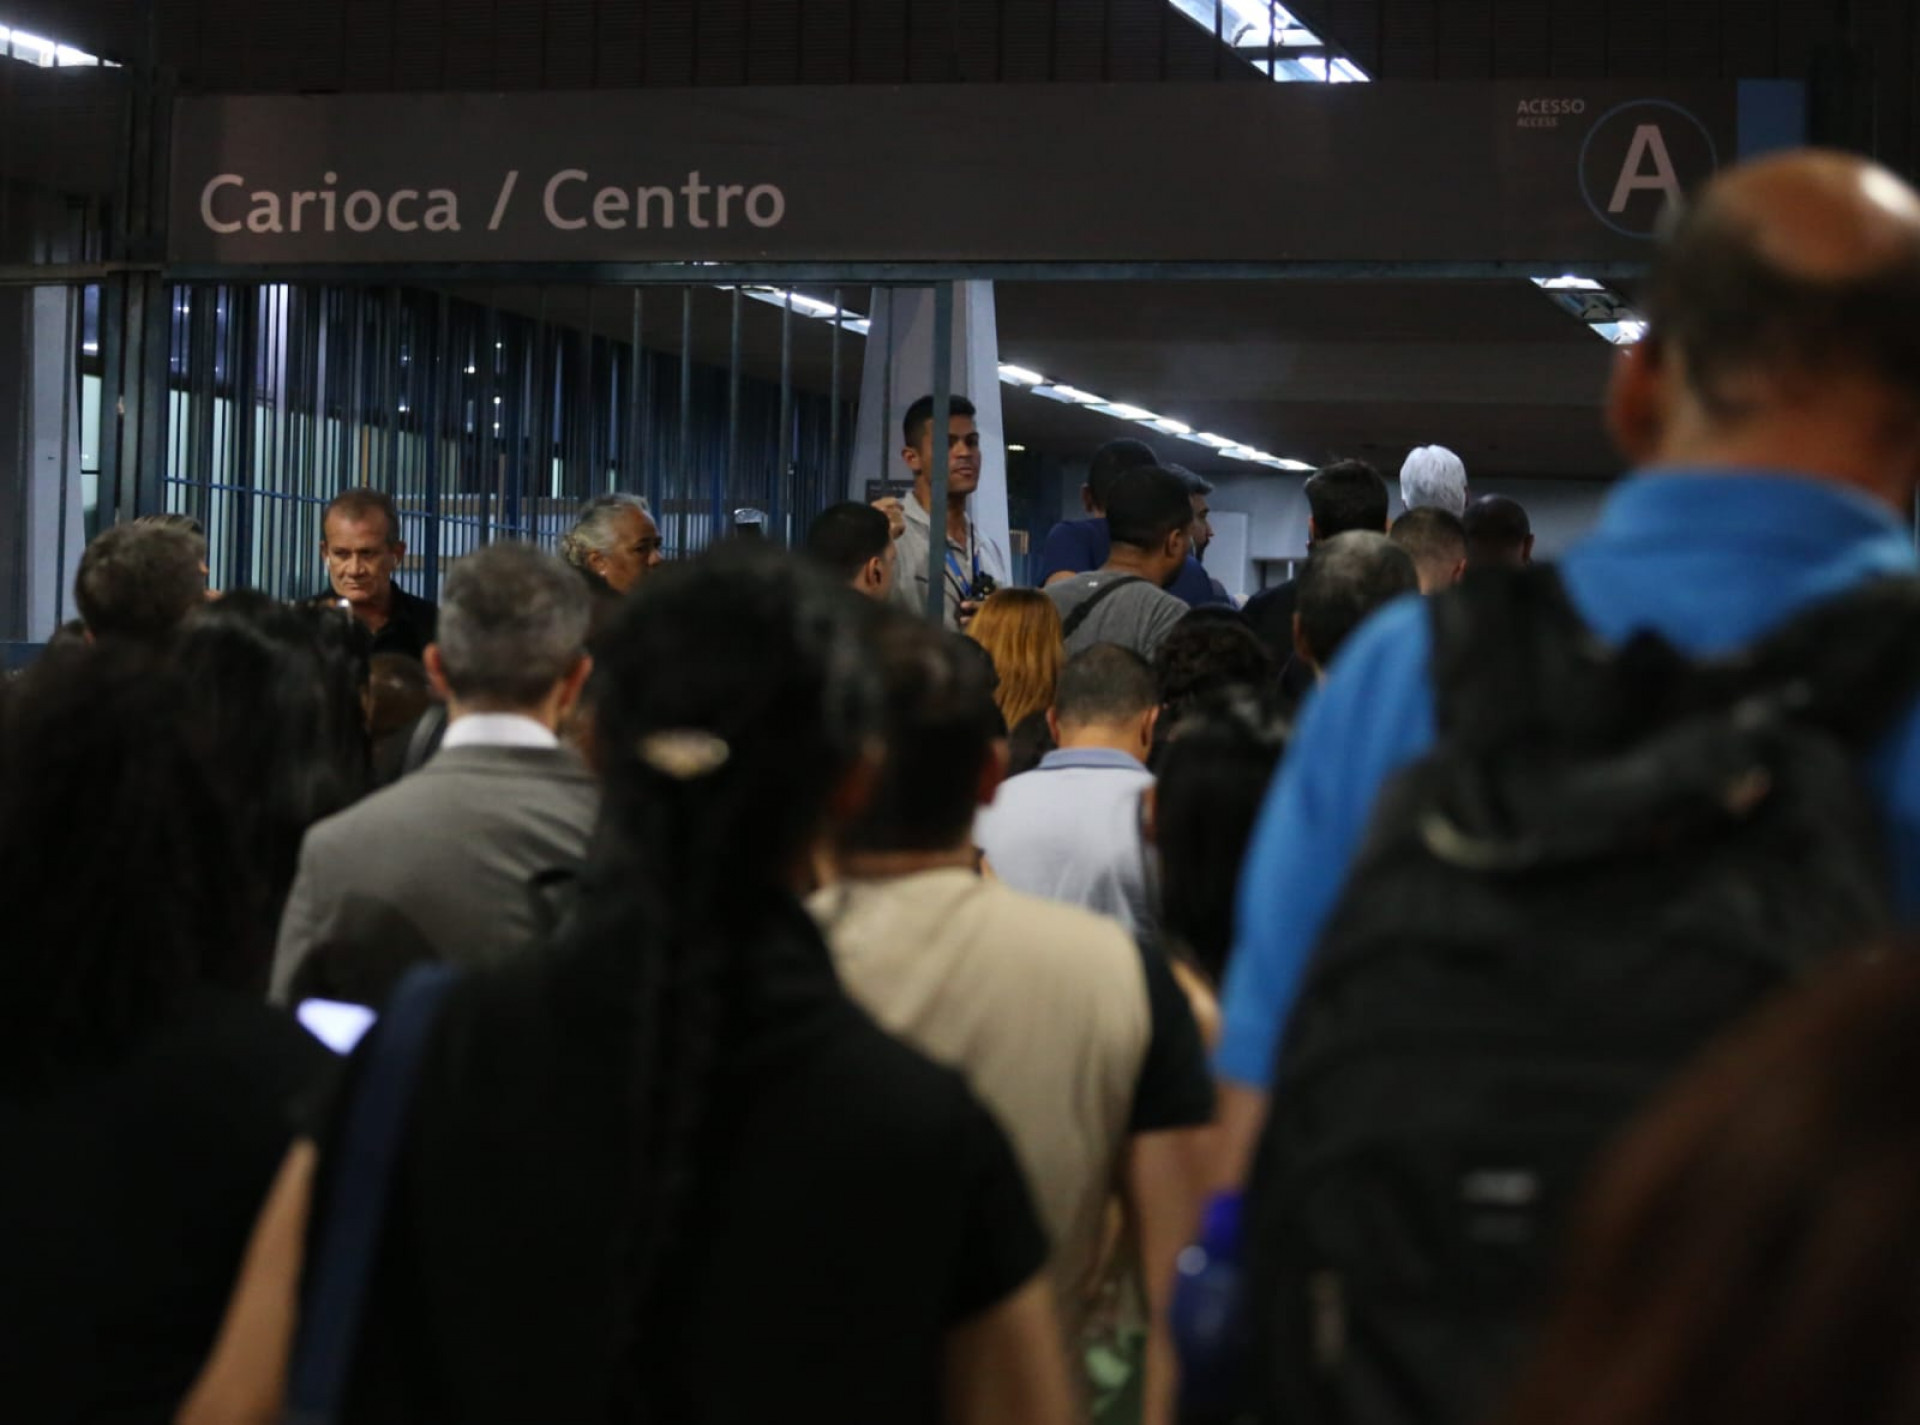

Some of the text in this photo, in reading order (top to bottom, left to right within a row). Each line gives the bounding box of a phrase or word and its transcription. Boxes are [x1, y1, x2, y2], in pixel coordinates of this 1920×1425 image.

[1517, 99, 1585, 114] ACESSO
[1517, 117, 1558, 128] ACCESS
[1608, 125, 1682, 212] A
[199, 169, 786, 233] Carioca / Centro
